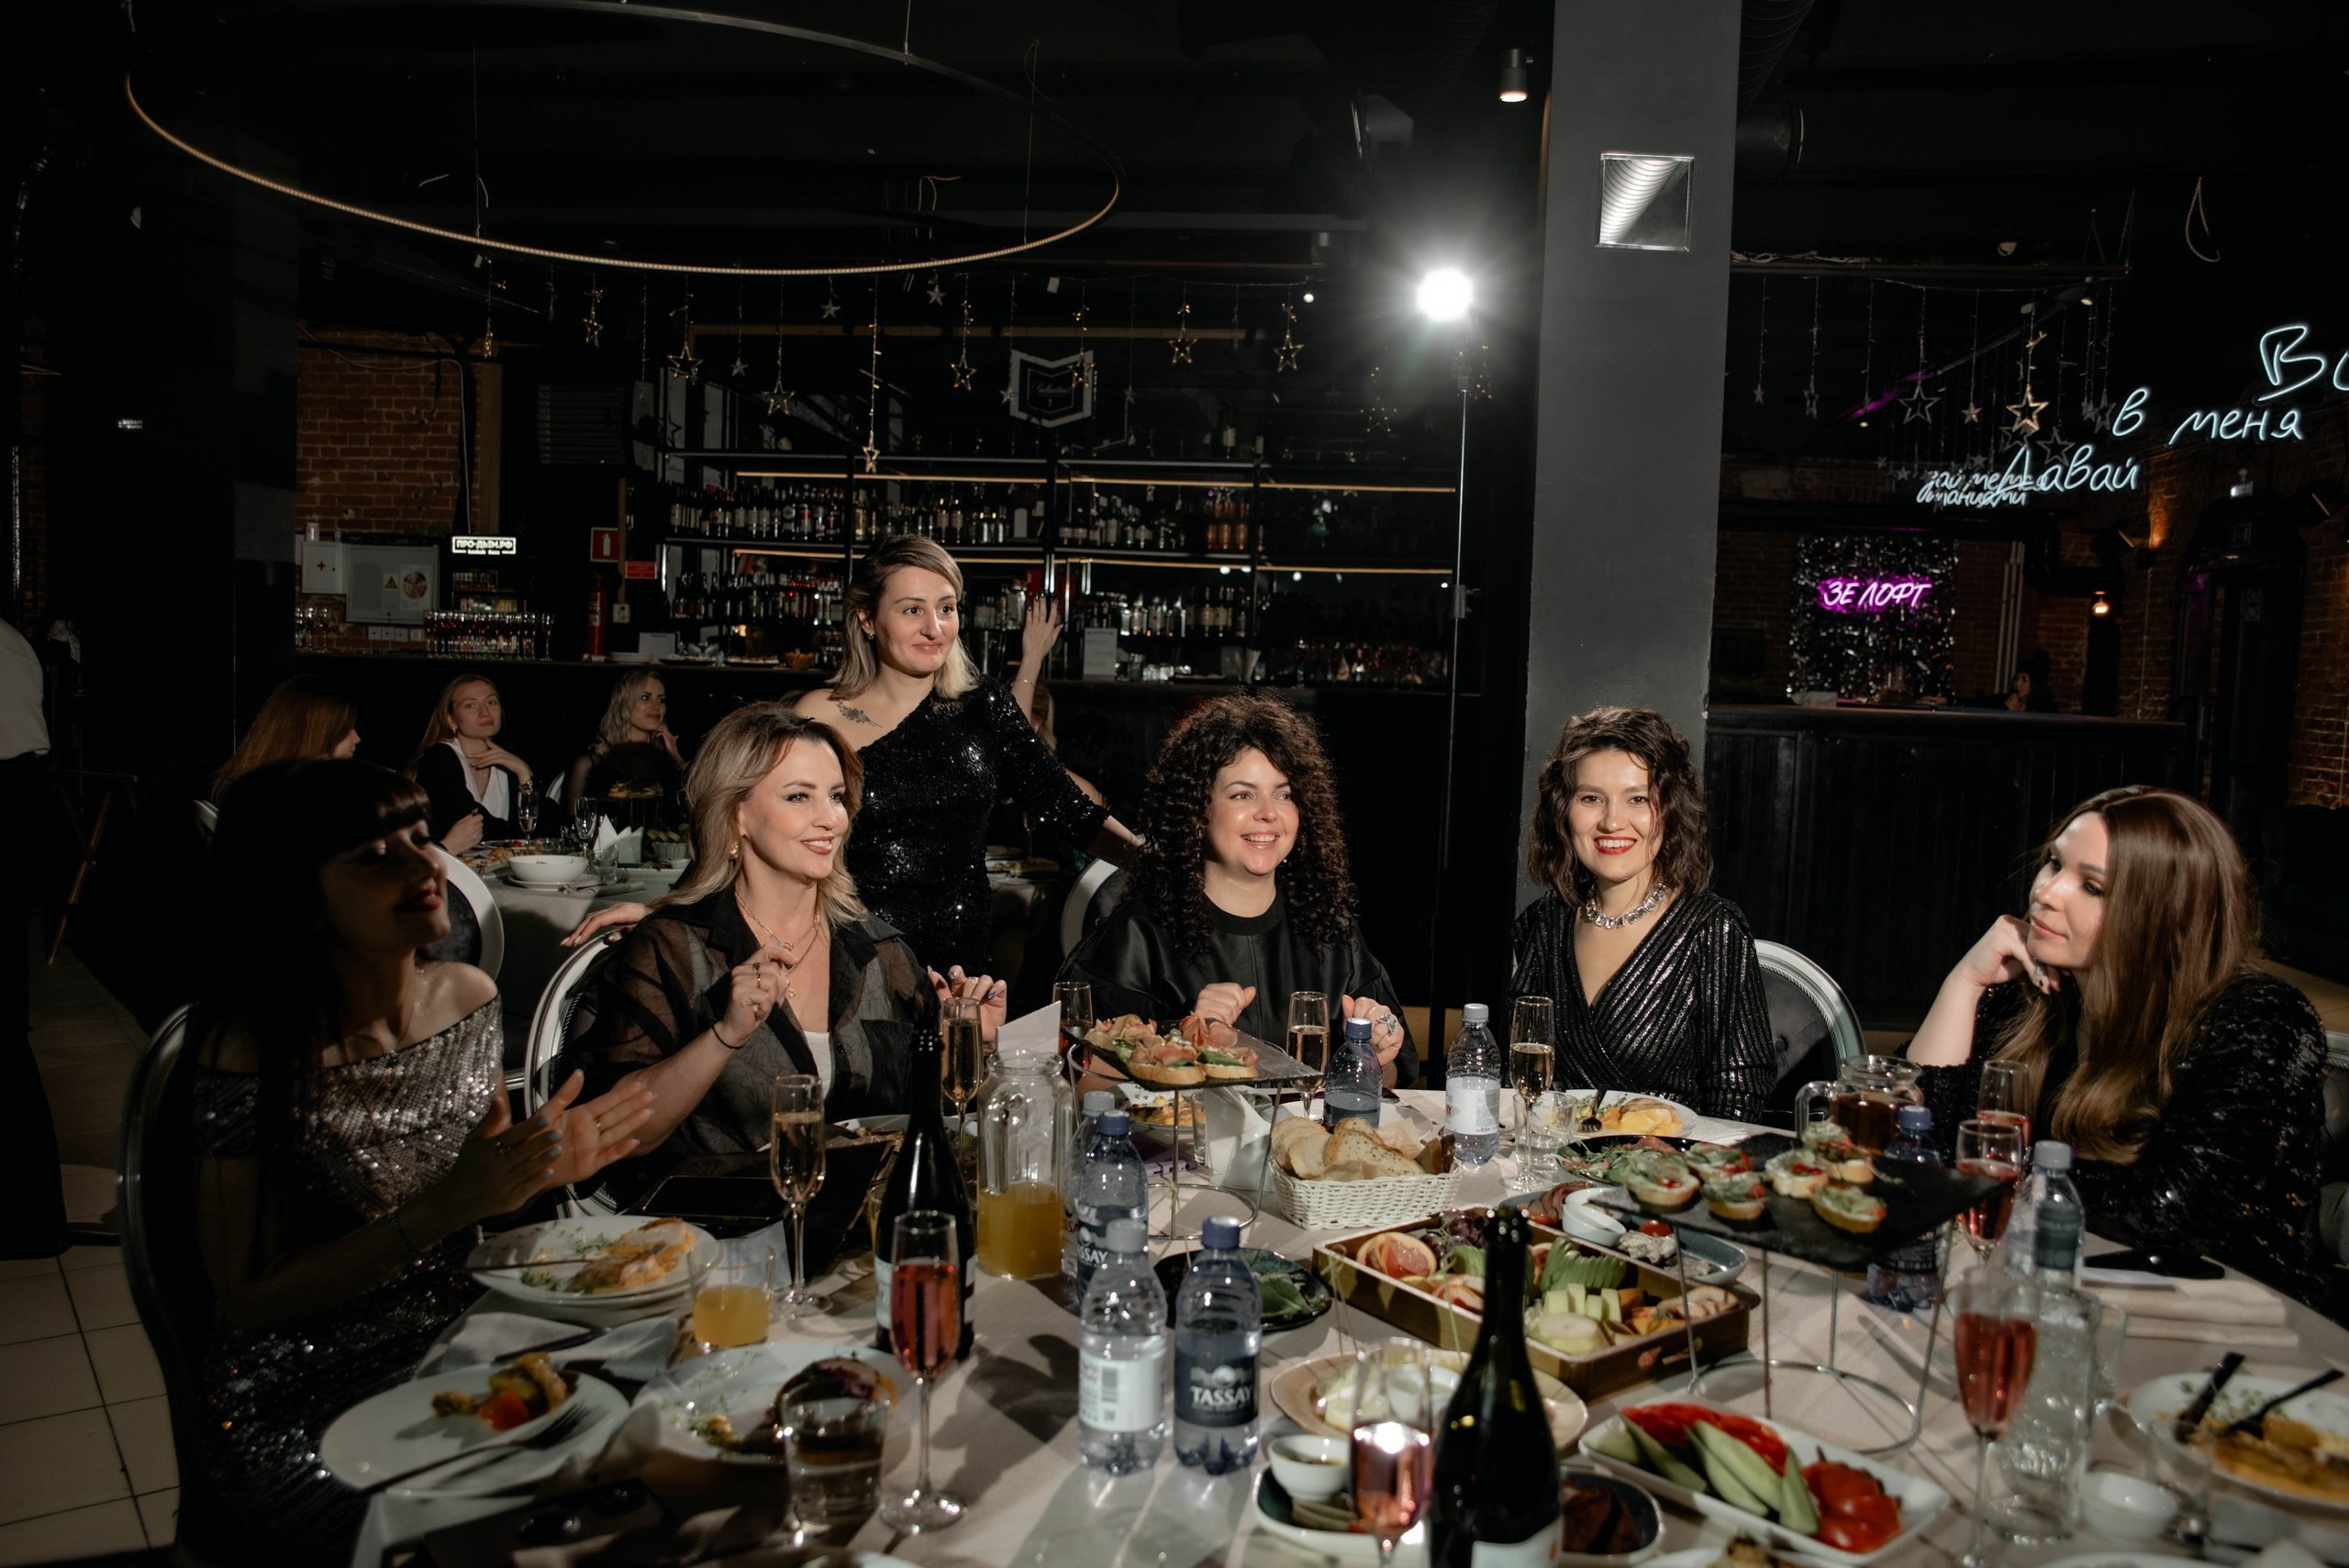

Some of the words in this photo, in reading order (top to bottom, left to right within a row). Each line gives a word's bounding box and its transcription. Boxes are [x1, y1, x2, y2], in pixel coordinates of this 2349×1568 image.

[2111, 387, 2149, 437] в
[2166, 409, 2304, 446] меня
[1983, 443, 2139, 504] Давай
[1823, 581, 1860, 606] ЗЕ
[1857, 581, 1932, 607] ЛОФТ
[1190, 1385, 1252, 1406] TASSAY
